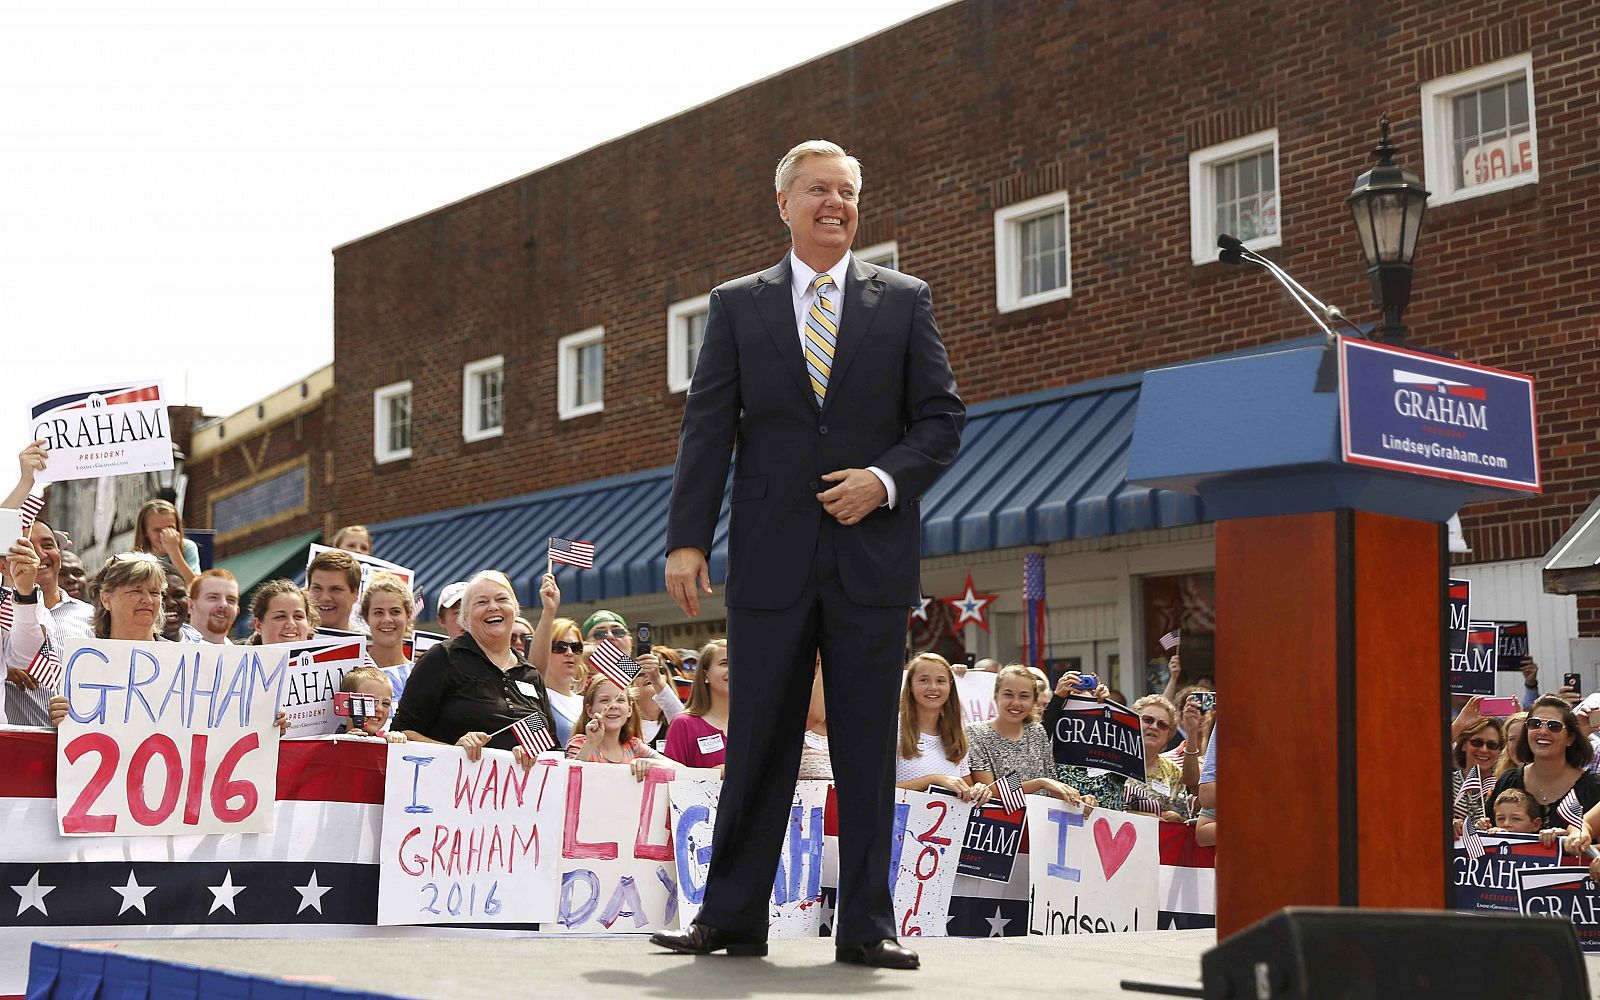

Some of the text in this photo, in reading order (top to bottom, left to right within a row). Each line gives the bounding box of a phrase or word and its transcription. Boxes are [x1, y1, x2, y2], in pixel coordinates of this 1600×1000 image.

[91, 399, 101, 409] 16
[1394, 388, 1489, 431] GRAHAM
[34, 408, 165, 452] GRAHAM
[79, 450, 126, 461] PRESIDENT
[1382, 433, 1508, 469] LindseyGraham.com
[301, 656, 309, 667] 16
[64, 647, 290, 729] GRAHAM
[289, 708, 327, 720] PRESIDENT
[1104, 709, 1111, 719] 16
[1055, 717, 1143, 760] GRAHAM
[62, 732, 261, 834] 2016
[402, 755, 559, 815] I WANT
[398, 823, 540, 878] GRAHAM
[1047, 807, 1085, 883] I
[1499, 845, 1508, 855] 16
[1454, 856, 1554, 891] GRAH
[1585, 881, 1595, 891] 16
[419, 880, 502, 917] 2016
